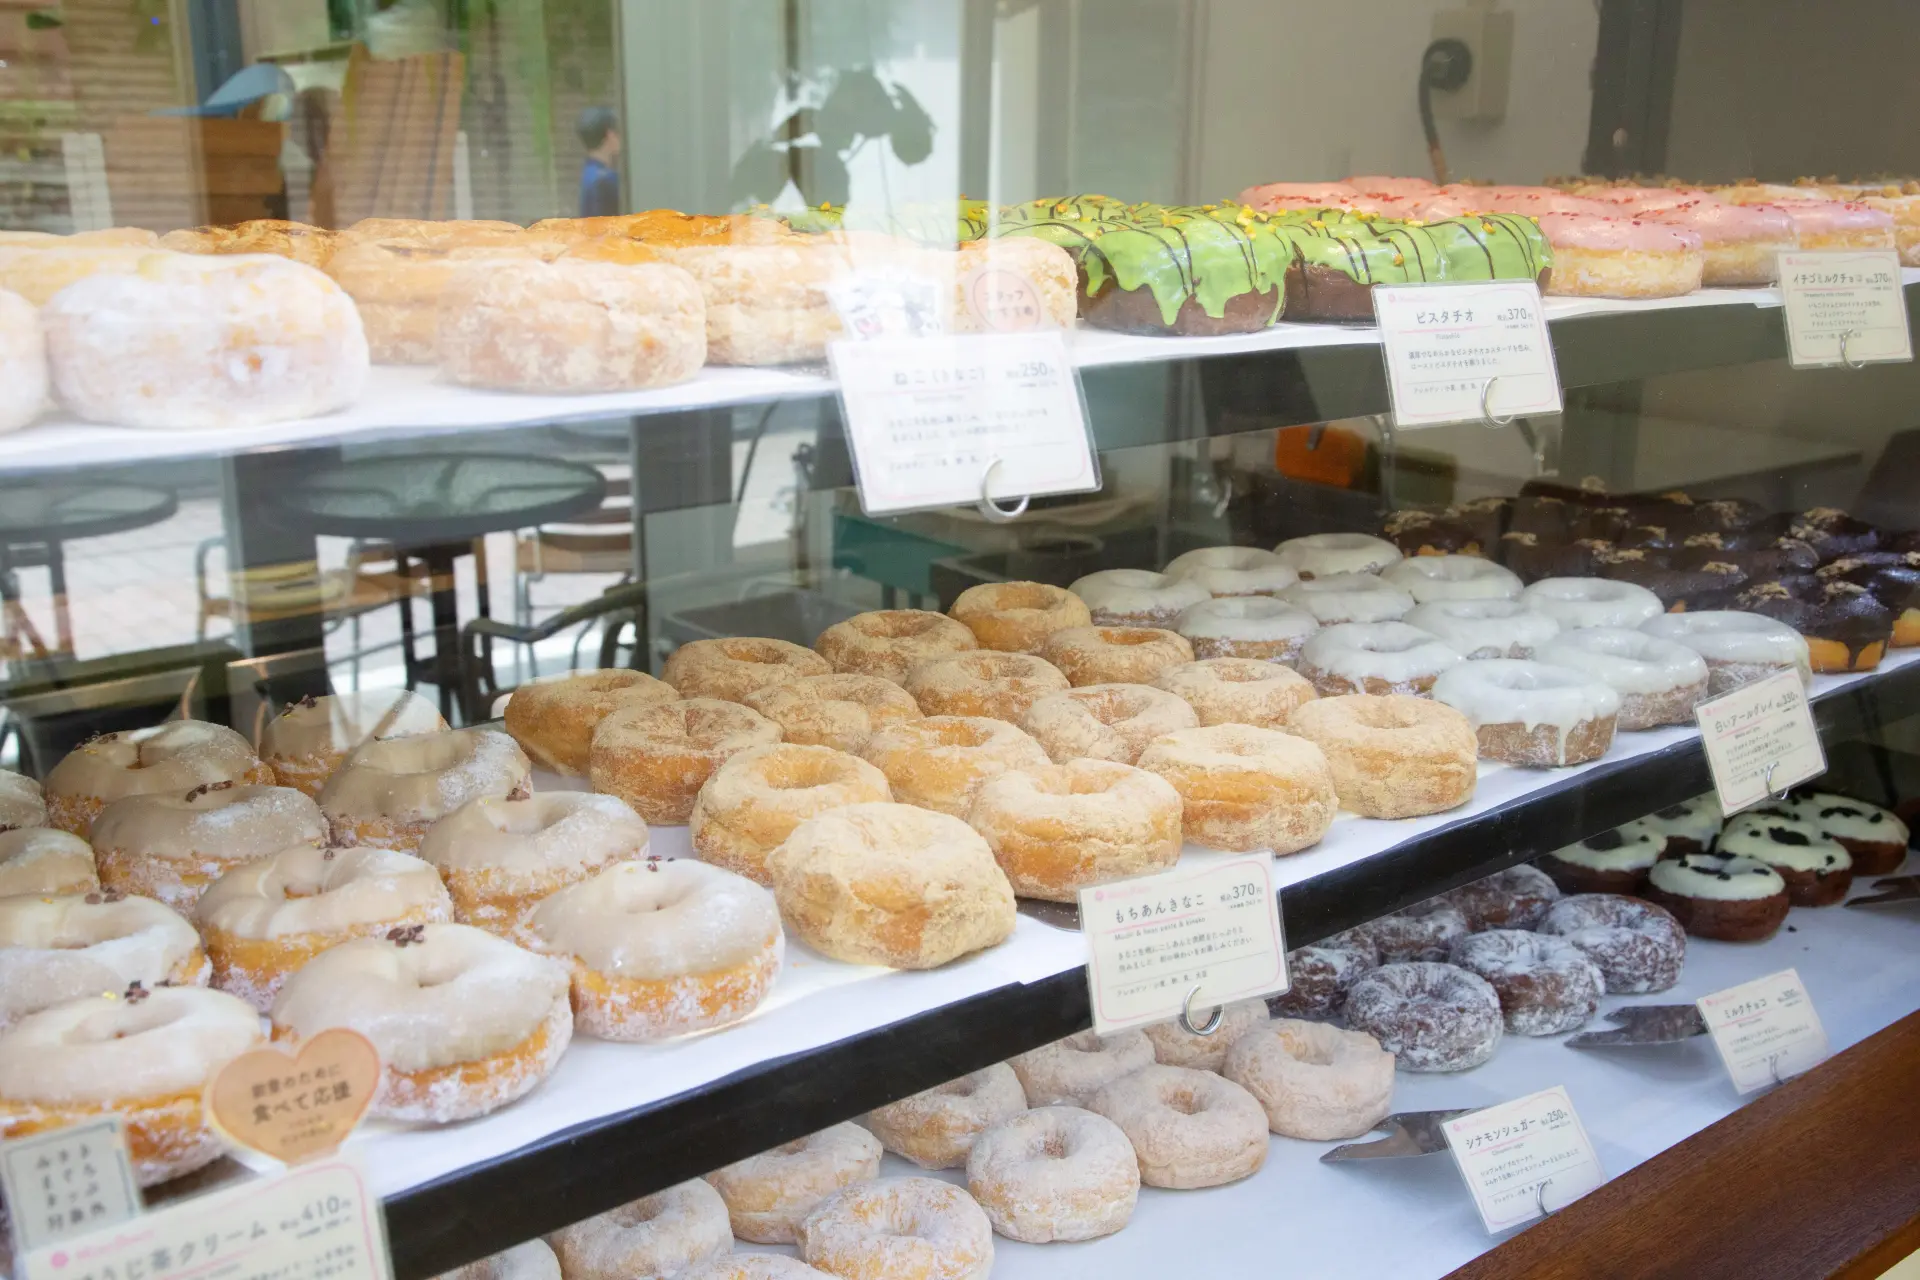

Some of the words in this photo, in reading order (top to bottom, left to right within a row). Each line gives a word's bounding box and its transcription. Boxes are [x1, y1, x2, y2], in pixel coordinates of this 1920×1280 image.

[1416, 308, 1474, 324] ピスタチオ
[1116, 893, 1205, 923] もちあんきなこ
[1465, 1118, 1536, 1149] シナモンシュガー
[80, 1220, 268, 1280] うじ茶クリーム
